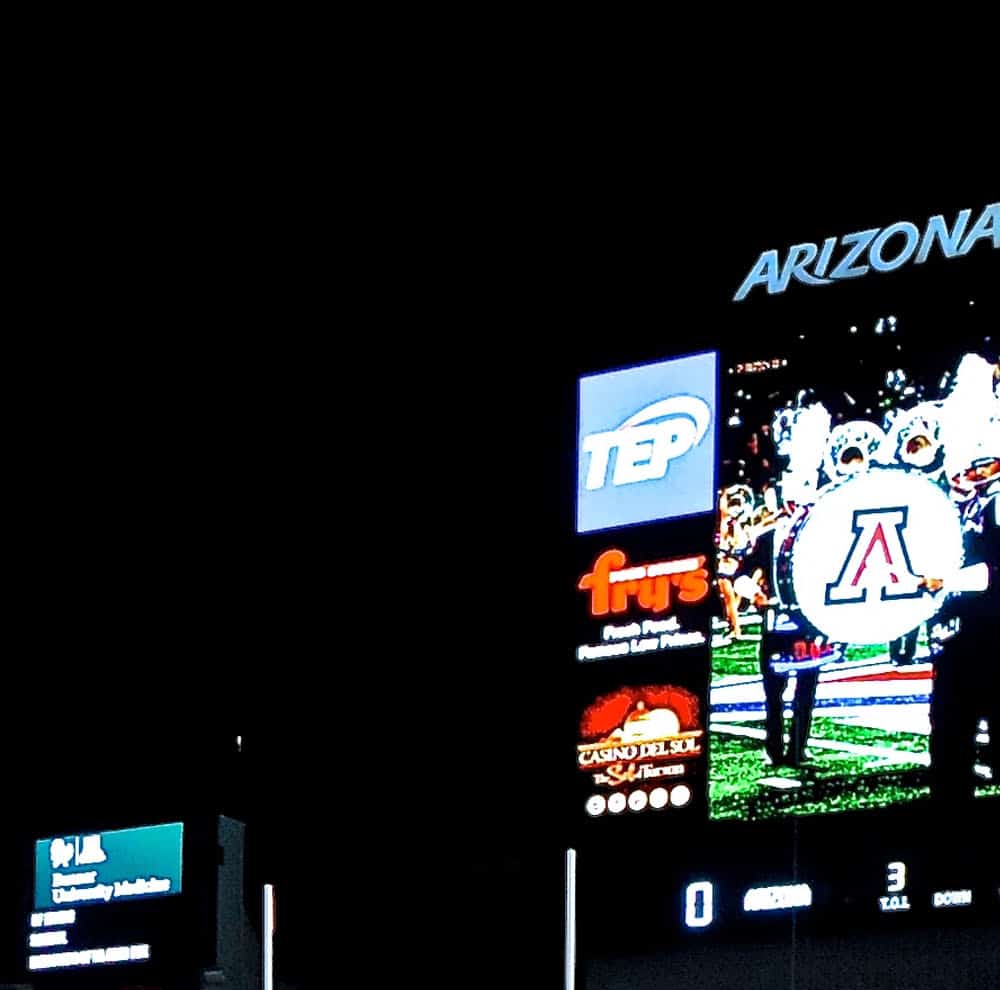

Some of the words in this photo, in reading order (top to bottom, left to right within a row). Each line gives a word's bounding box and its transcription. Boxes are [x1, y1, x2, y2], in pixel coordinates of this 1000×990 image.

[582, 422, 698, 490] TEP
[578, 745, 638, 765] CASINO
[887, 861, 906, 892] 3
[685, 881, 713, 928] 0
